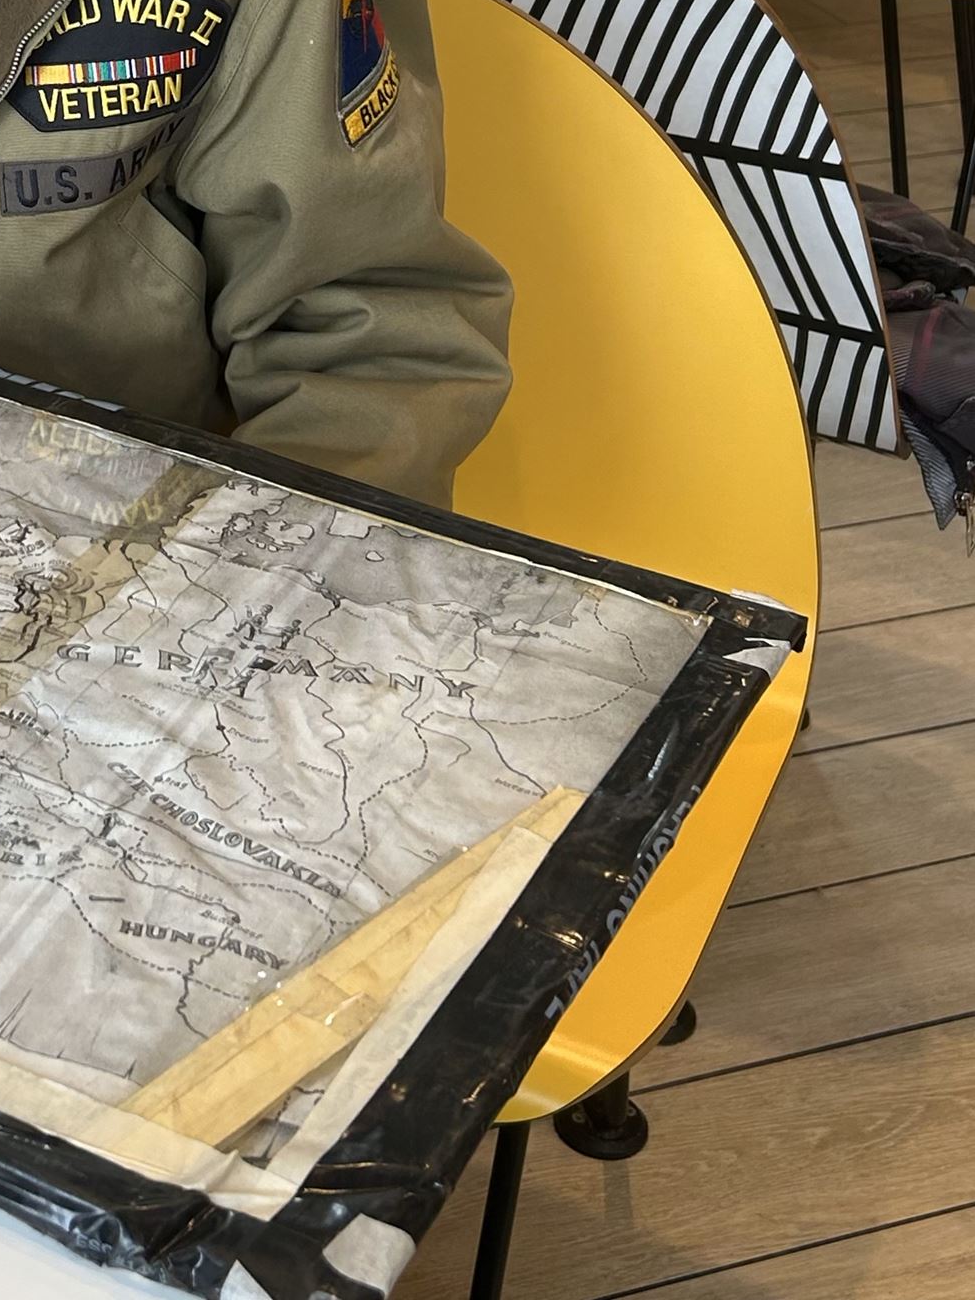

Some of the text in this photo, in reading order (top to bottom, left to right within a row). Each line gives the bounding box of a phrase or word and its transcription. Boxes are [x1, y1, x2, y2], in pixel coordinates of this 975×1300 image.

[190, 9, 223, 46] II
[38, 73, 183, 122] VETERAN
[15, 116, 186, 208] U.S. ARMY
[56, 643, 479, 698] GERMANY
[106, 761, 343, 899] CZECHOSLOVAKIA
[119, 917, 291, 973] HUNGARY
